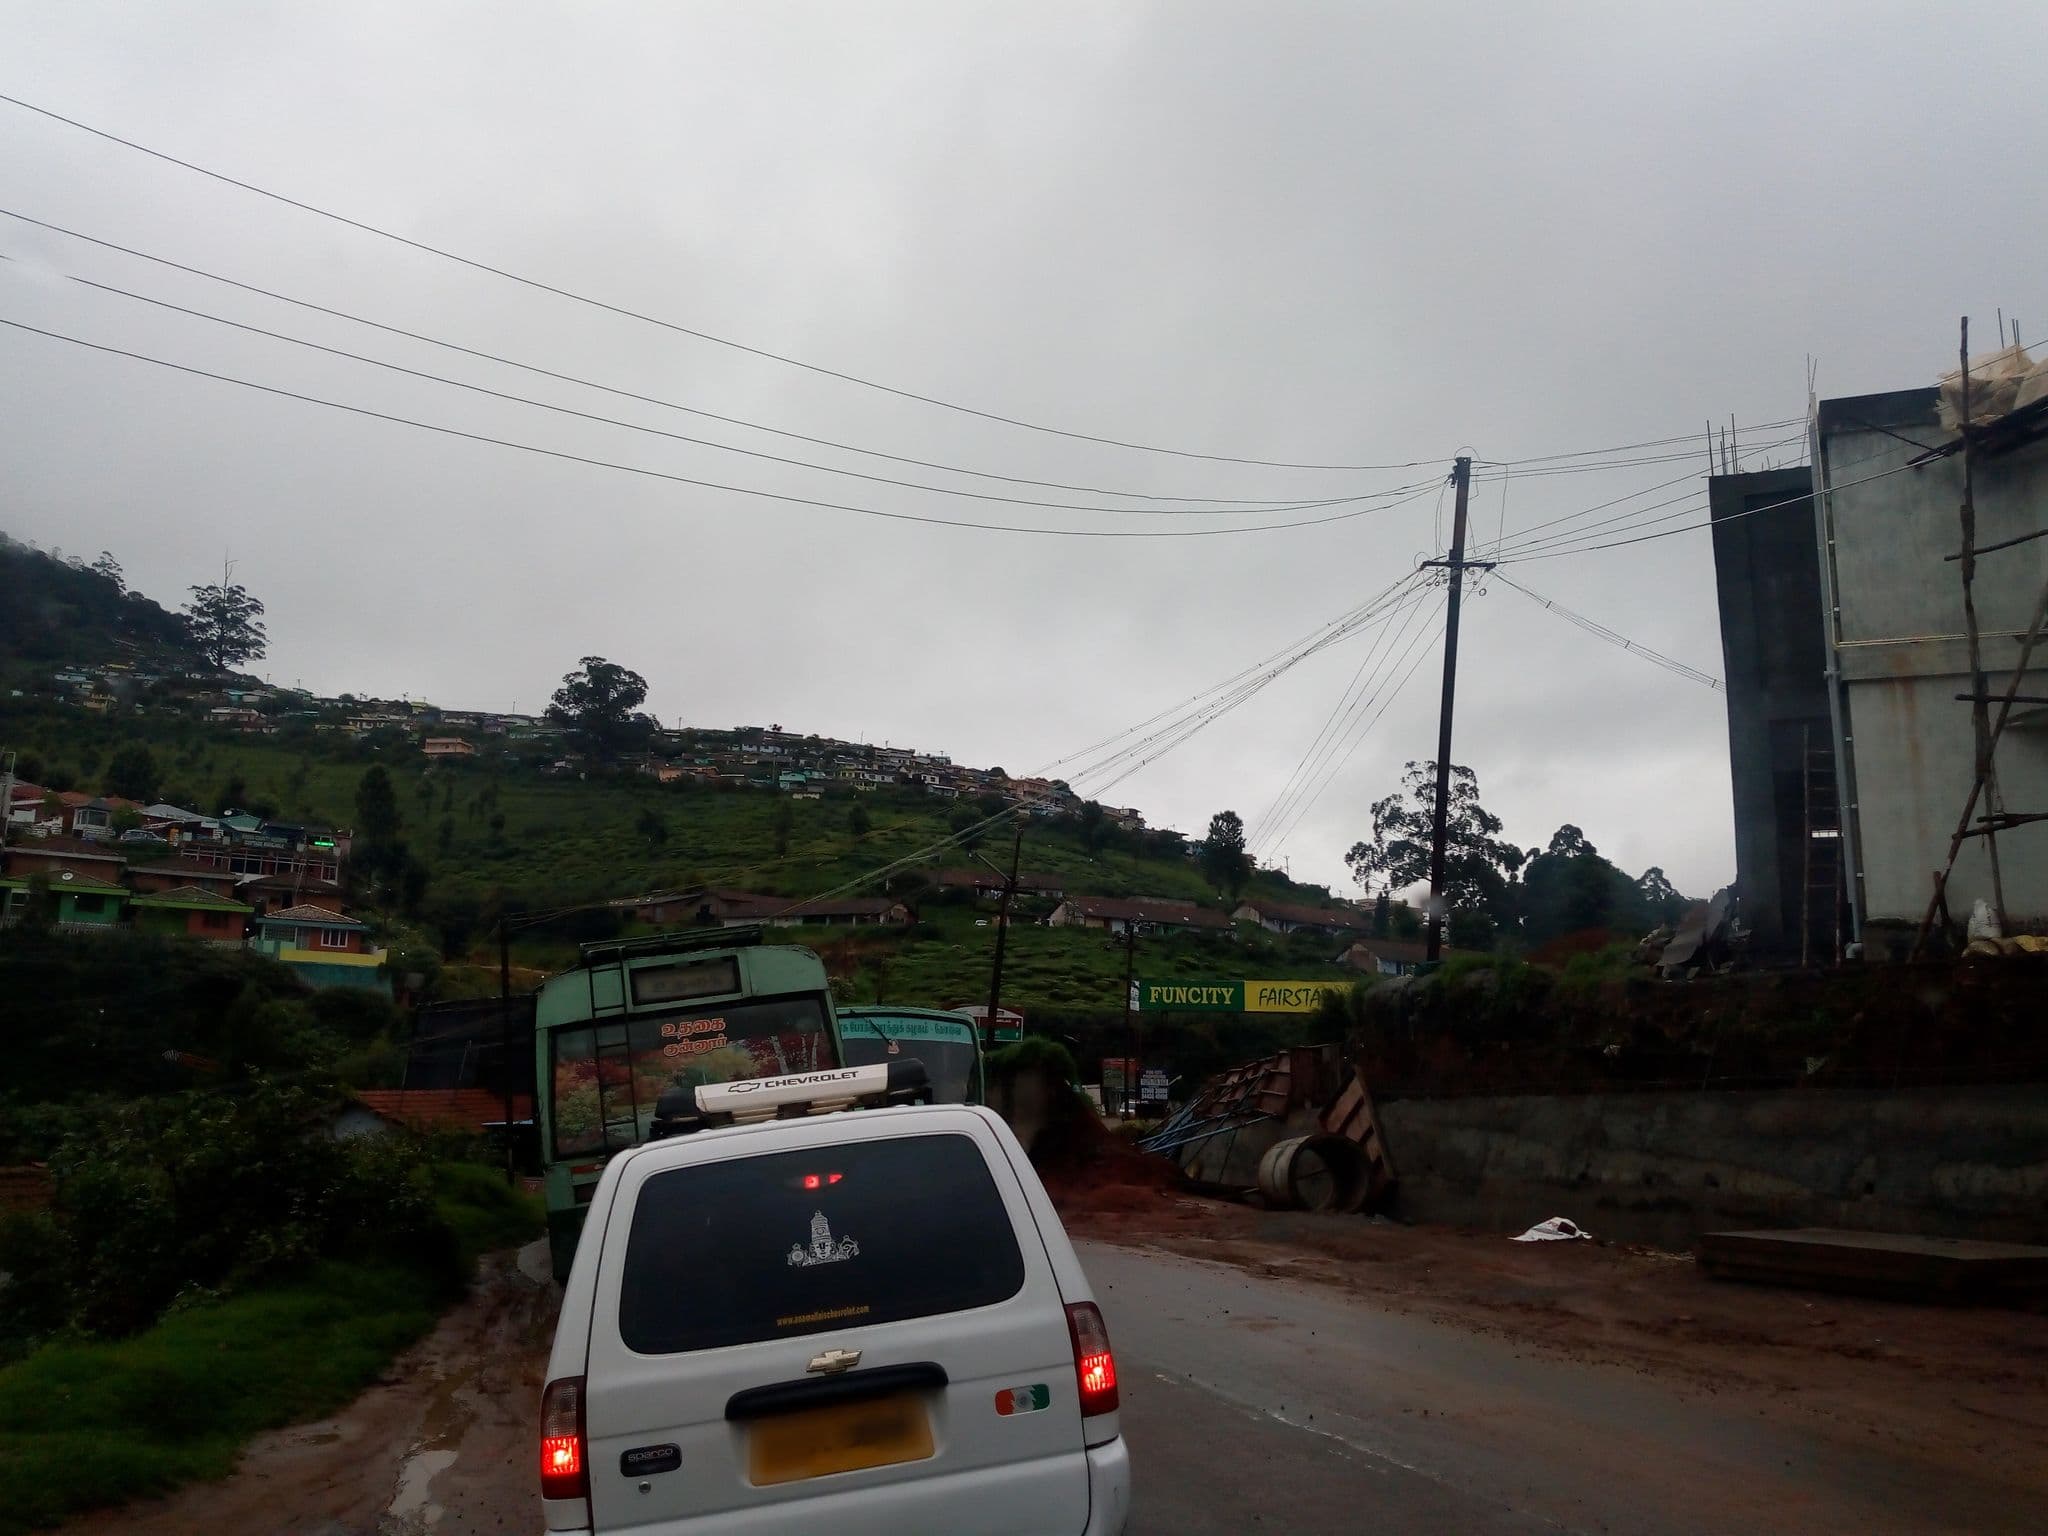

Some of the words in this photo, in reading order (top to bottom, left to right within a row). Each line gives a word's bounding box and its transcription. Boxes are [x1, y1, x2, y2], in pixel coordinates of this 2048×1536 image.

[1149, 986, 1235, 1005] FUNCITY
[1258, 986, 1321, 1007] FAIRSTA
[661, 1018, 726, 1040] உதகை
[663, 1033, 728, 1057] குன்னூர்
[764, 1070, 859, 1088] CHEVROLET
